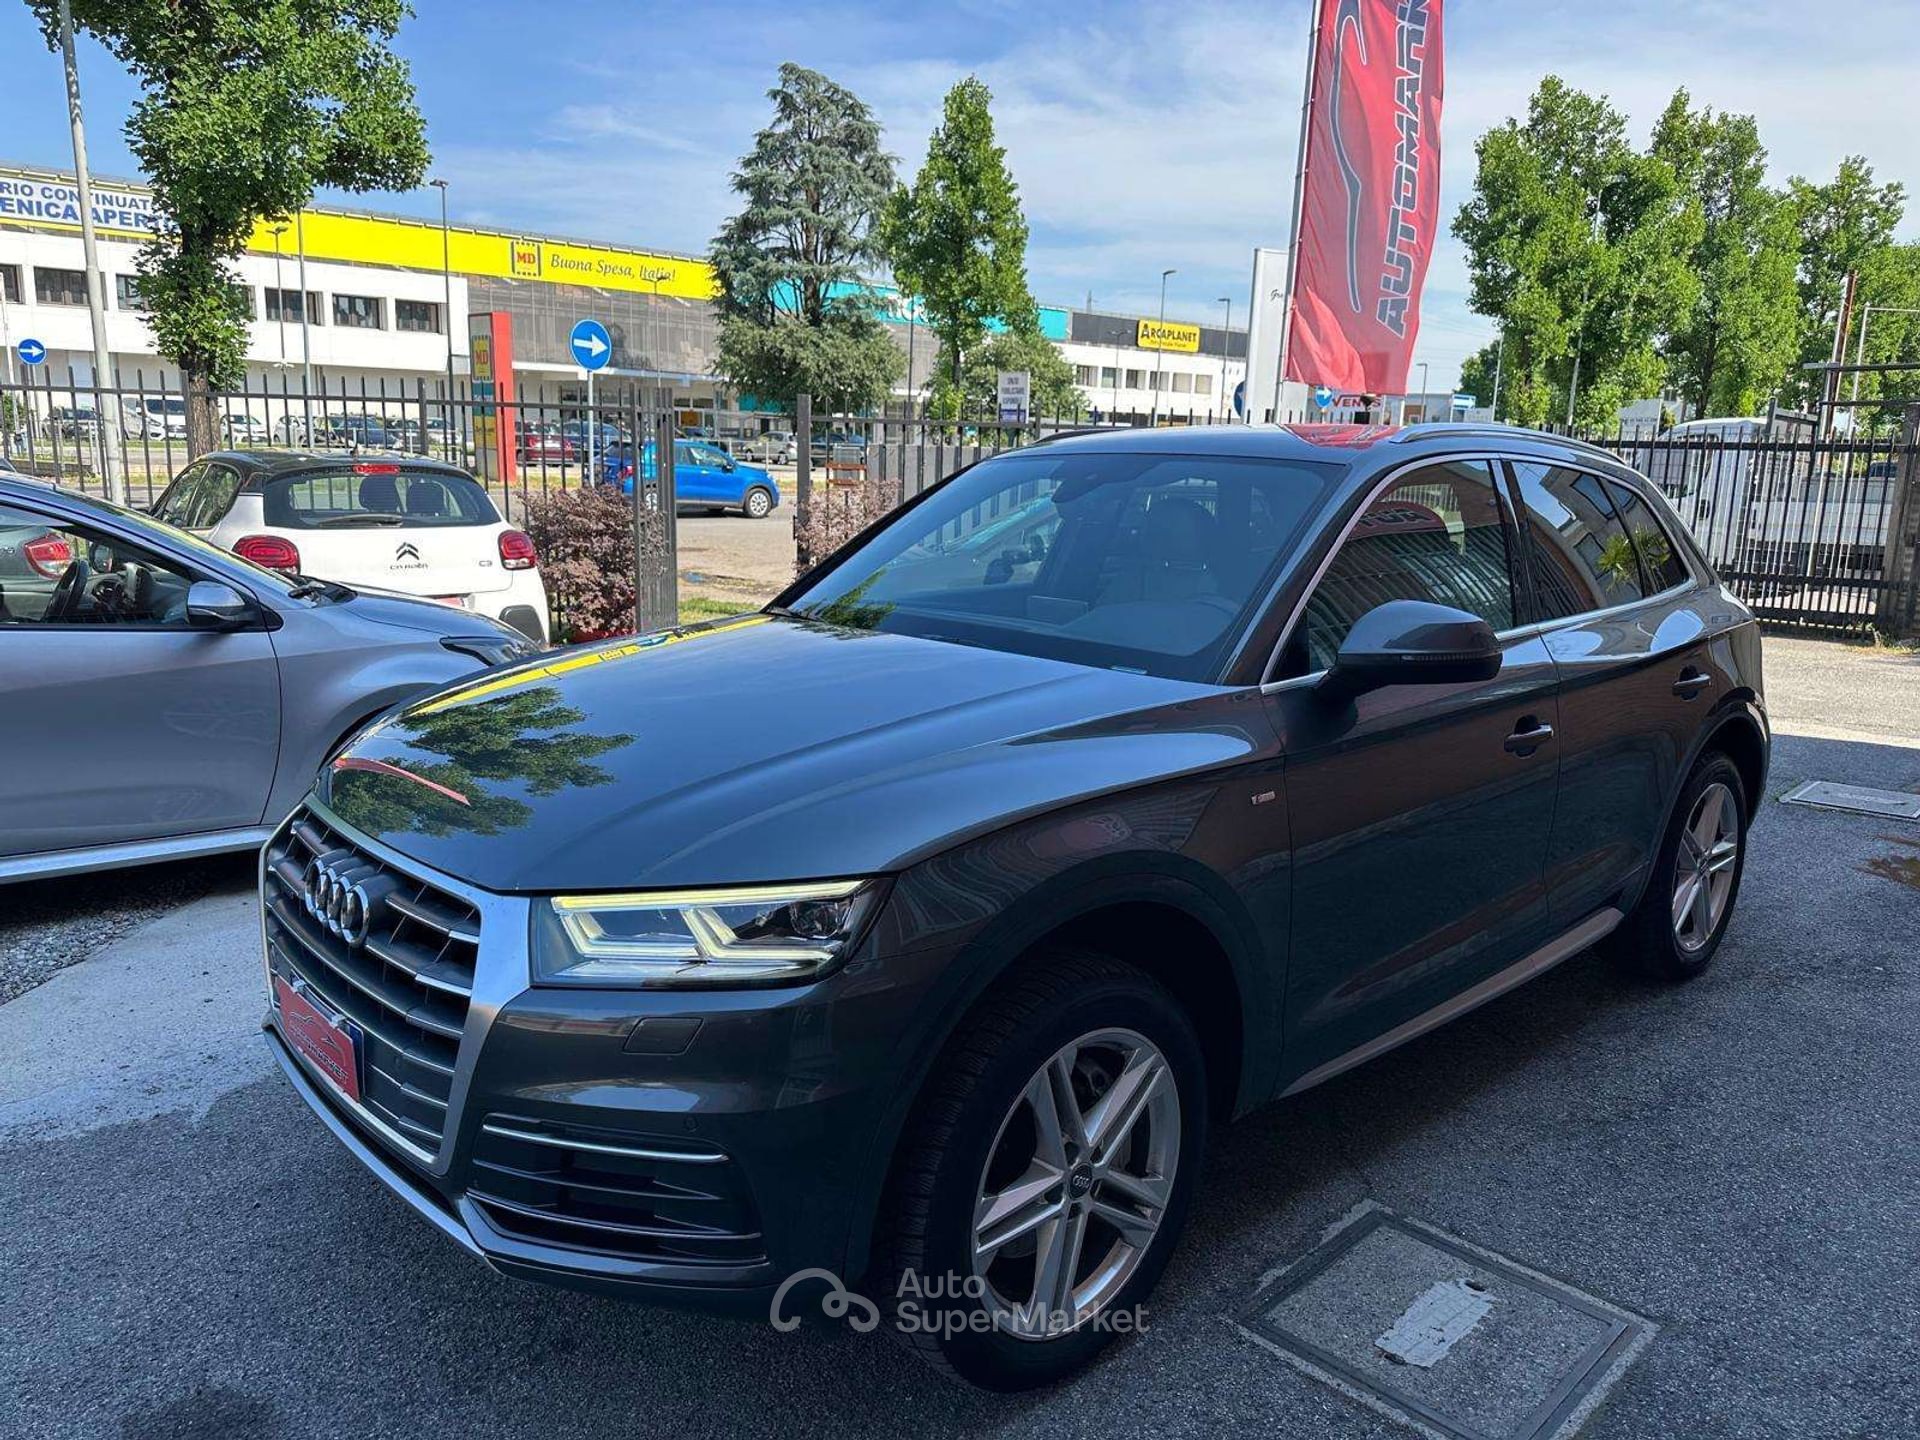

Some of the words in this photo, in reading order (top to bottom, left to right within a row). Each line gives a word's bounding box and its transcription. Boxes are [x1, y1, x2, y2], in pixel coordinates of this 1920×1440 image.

[516, 252, 536, 264] MD
[550, 253, 592, 271] Buona
[595, 259, 636, 279] Spesa,
[1140, 323, 1197, 342] ARCAPLANET
